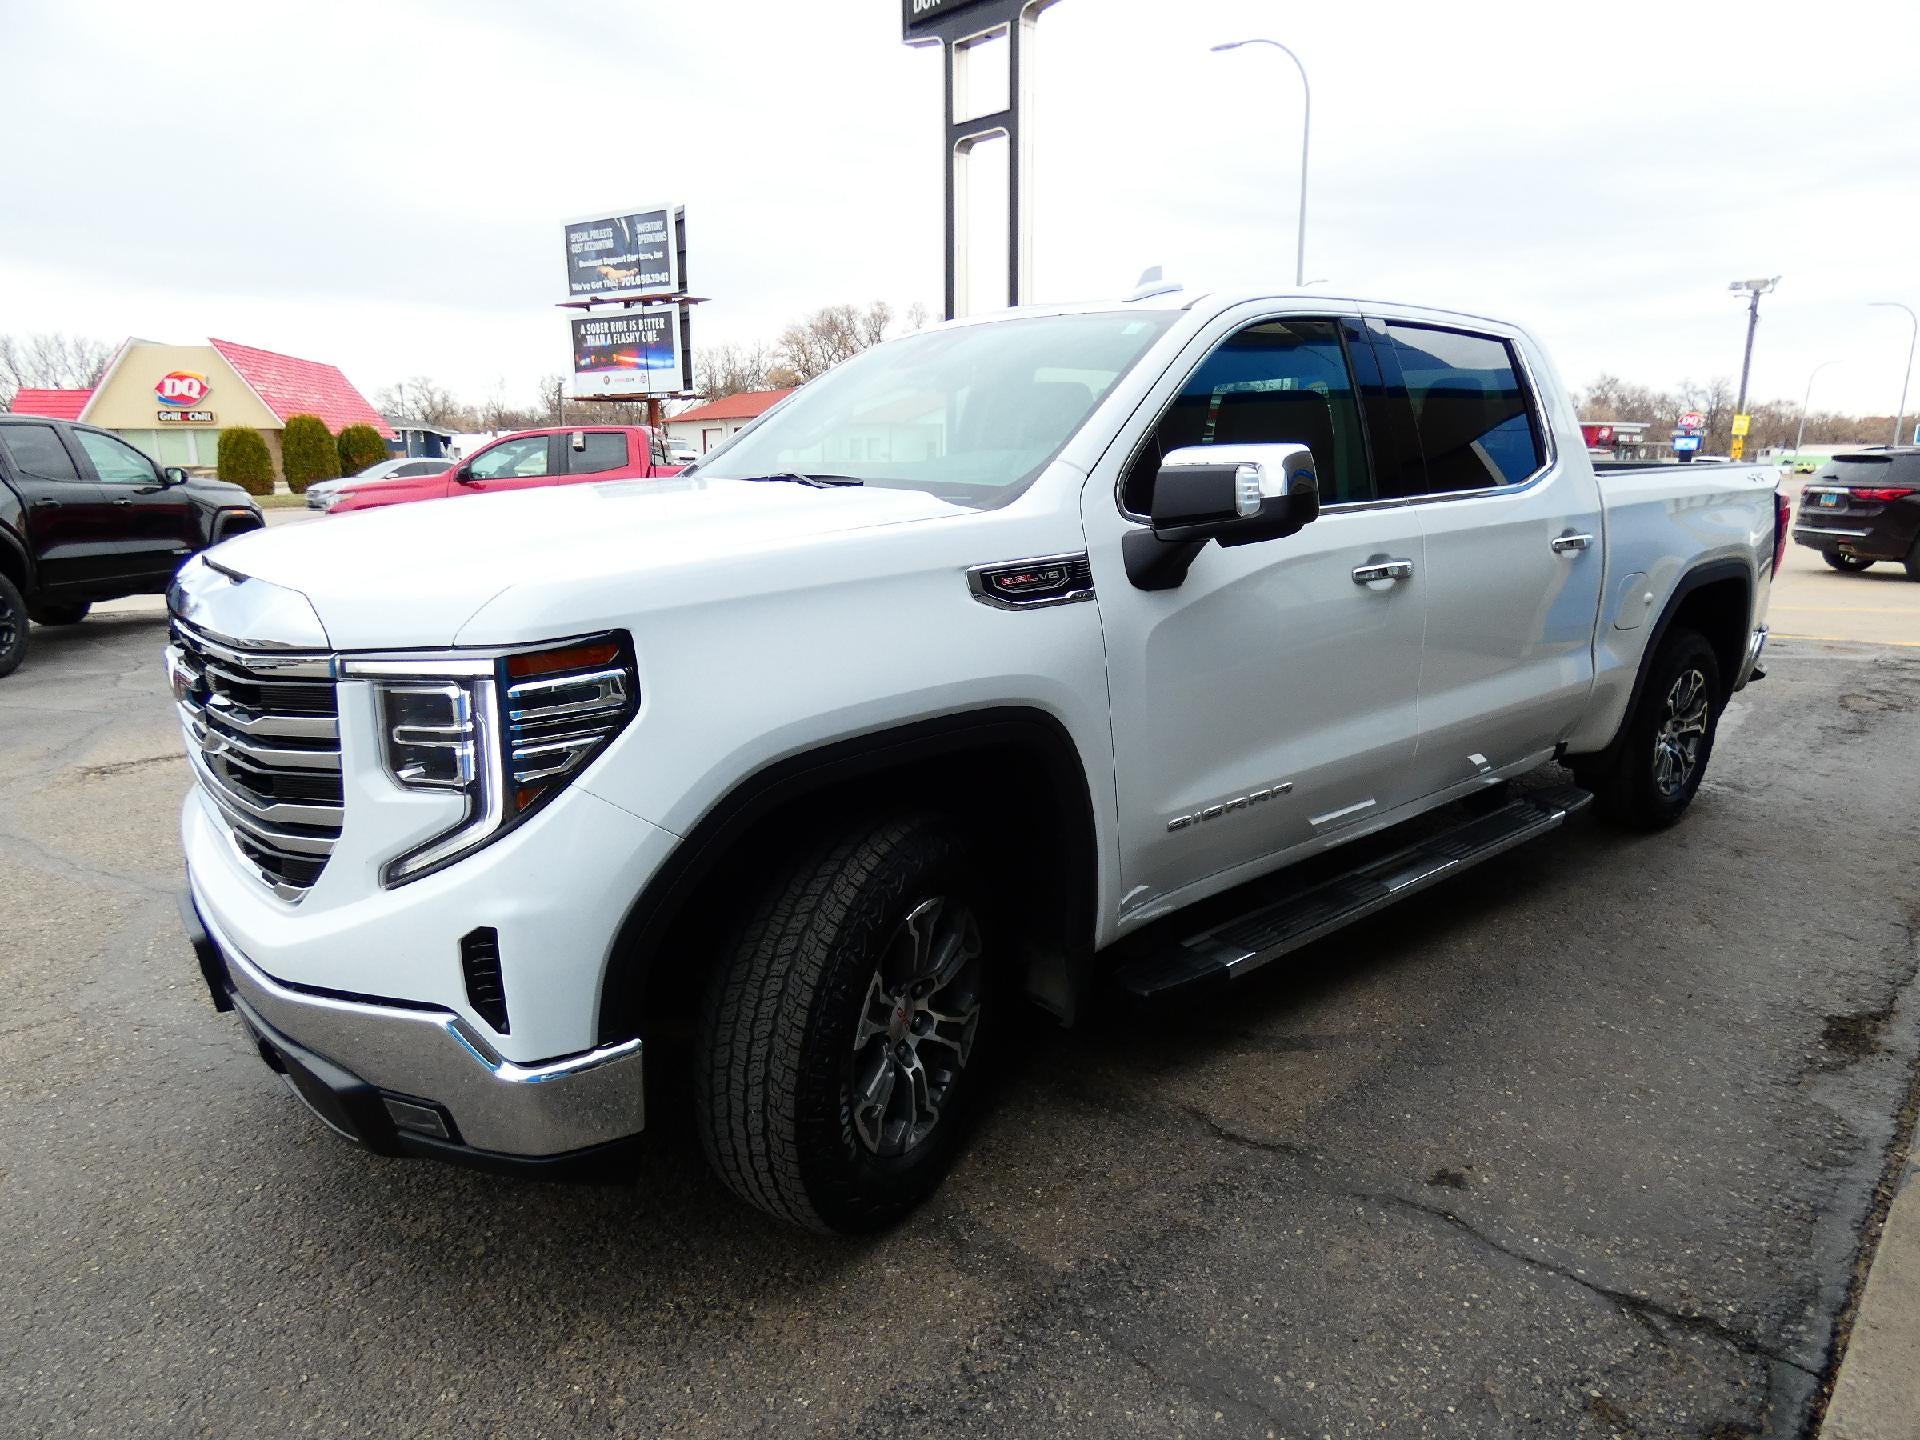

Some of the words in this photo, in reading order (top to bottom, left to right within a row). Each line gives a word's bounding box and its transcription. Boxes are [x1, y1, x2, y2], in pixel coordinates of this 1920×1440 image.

[580, 325, 586, 335] A
[586, 322, 609, 334] SOBER
[610, 320, 628, 332] RIDE
[629, 320, 637, 331] IS
[638, 318, 665, 331] BETTER
[586, 334, 606, 346] THAN
[606, 334, 612, 345] A
[614, 330, 640, 344] FLASHY
[163, 378, 201, 399] DQ
[1167, 782, 1293, 832] SIERRA
